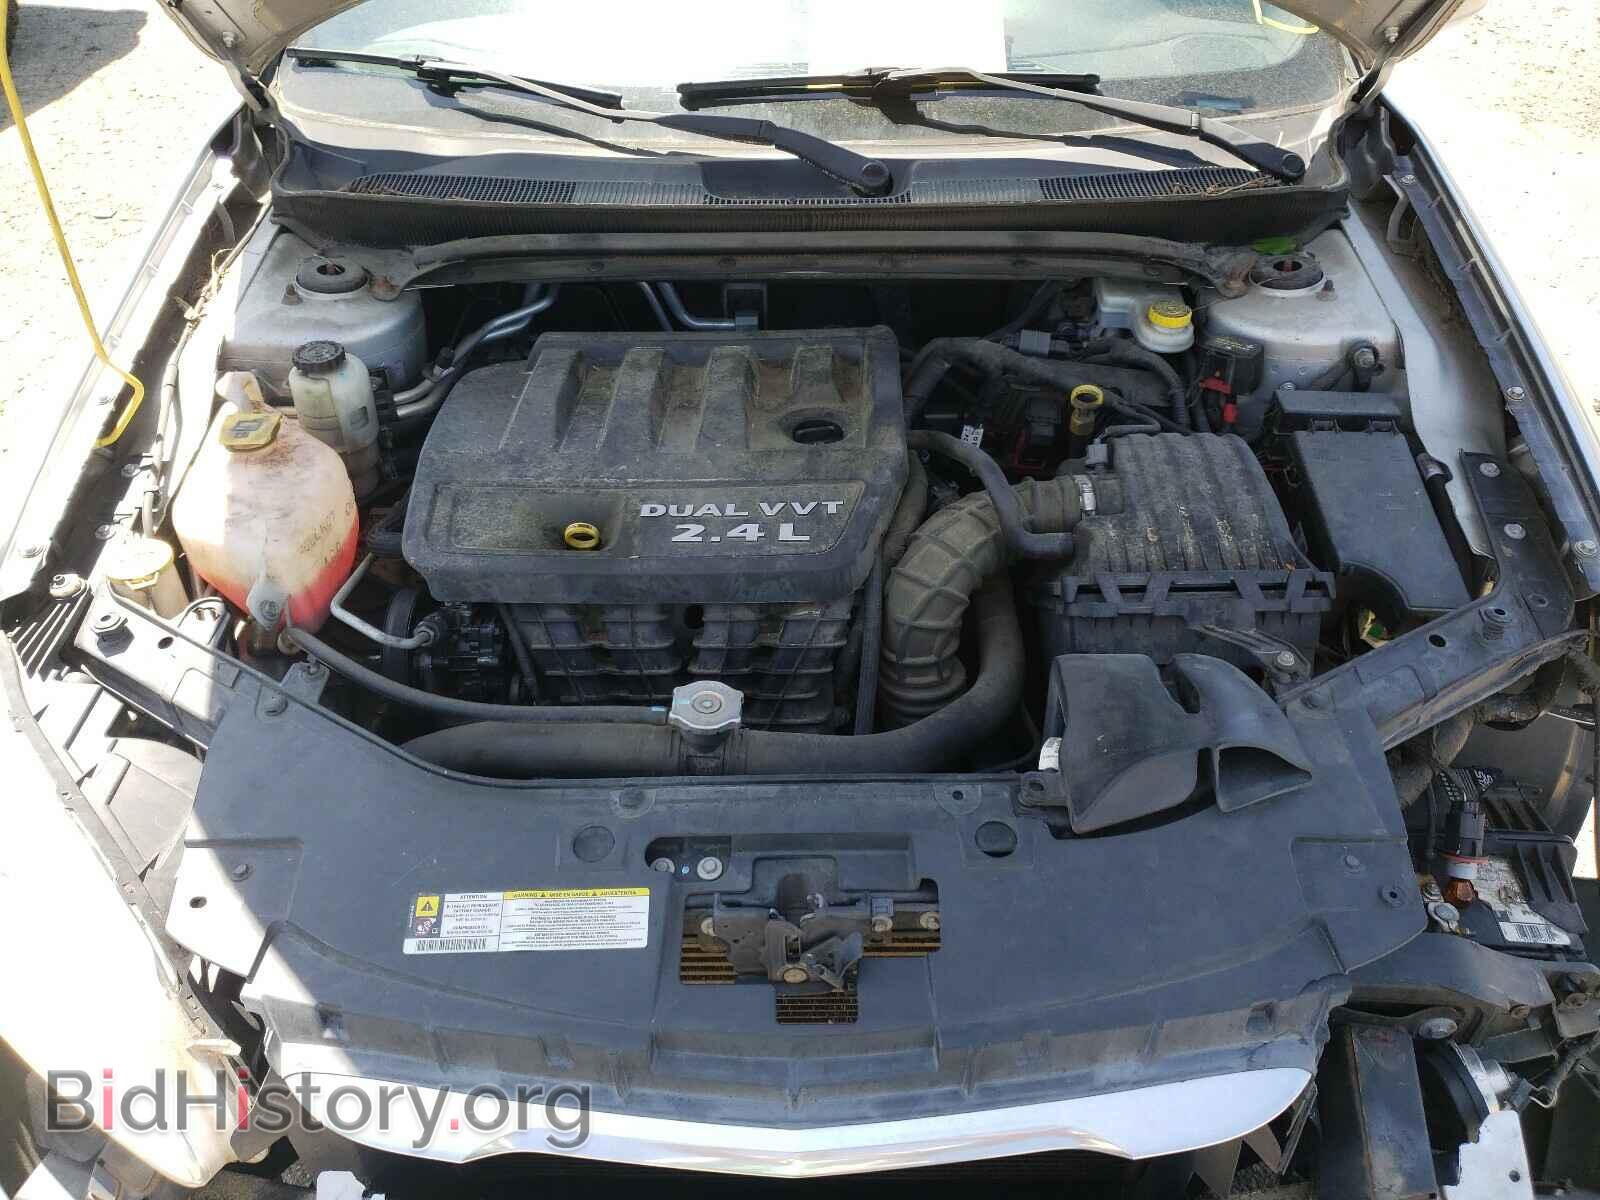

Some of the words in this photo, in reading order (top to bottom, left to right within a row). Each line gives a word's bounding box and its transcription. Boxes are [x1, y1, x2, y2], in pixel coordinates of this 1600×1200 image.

[639, 503, 749, 517] DUAL
[759, 501, 844, 516] VVT
[671, 523, 766, 542] 2.4
